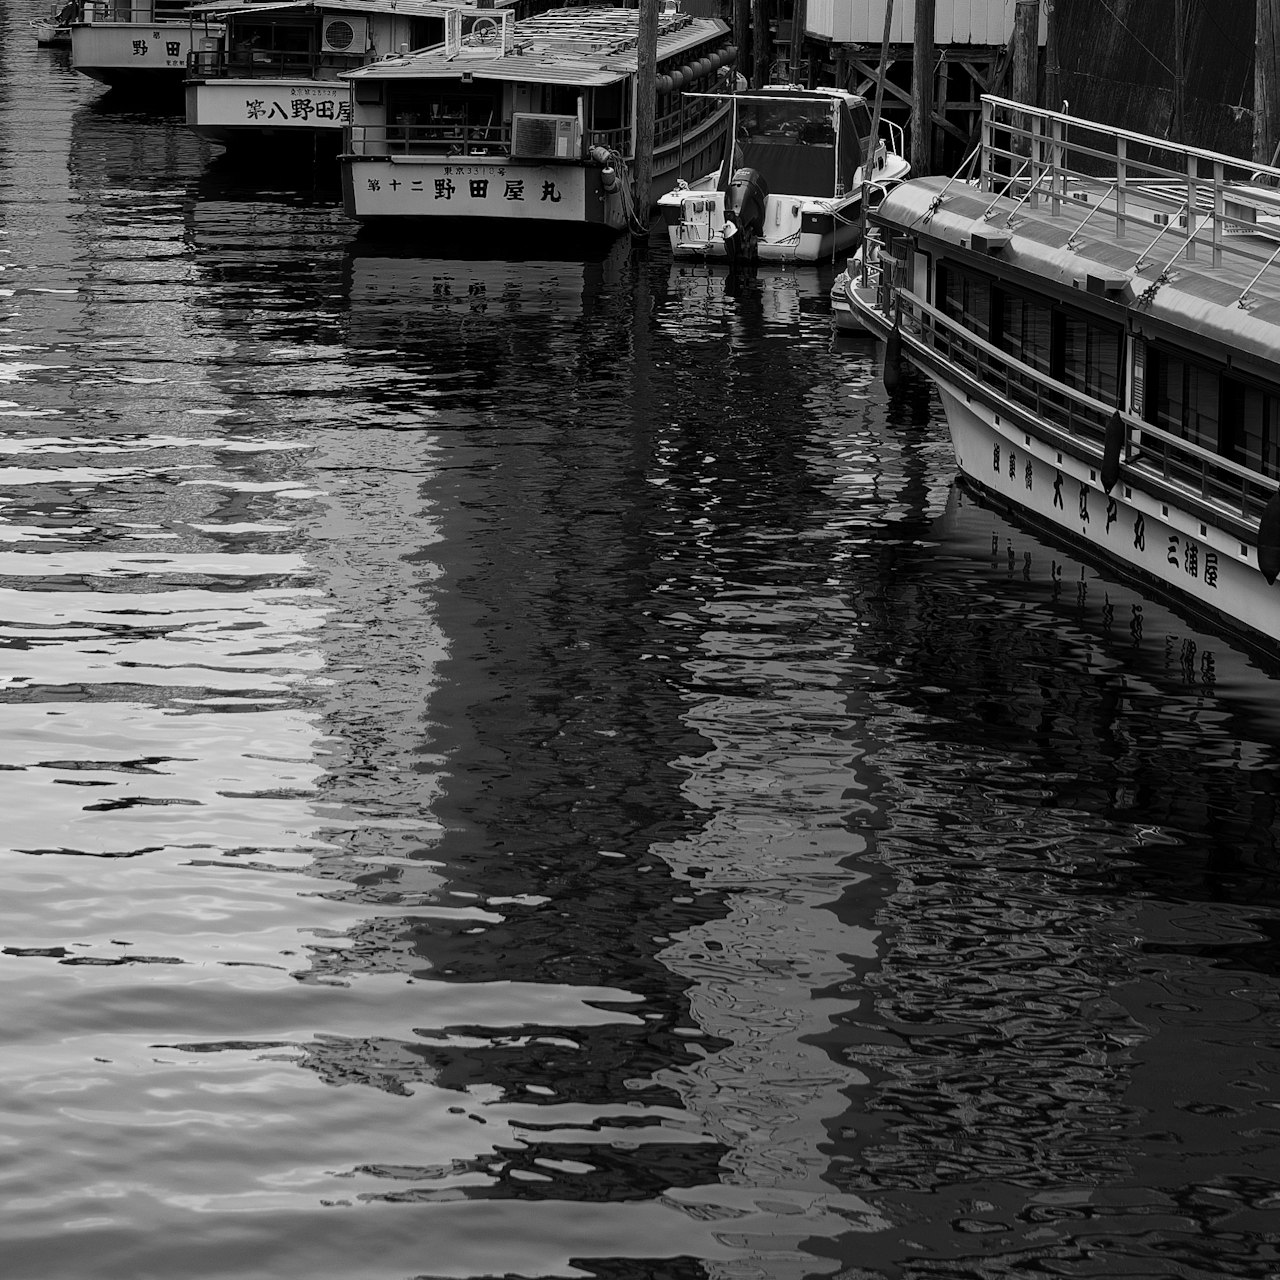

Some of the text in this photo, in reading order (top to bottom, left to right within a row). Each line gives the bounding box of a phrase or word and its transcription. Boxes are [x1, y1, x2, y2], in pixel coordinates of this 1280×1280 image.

[133, 39, 181, 57] 野田
[246, 99, 355, 122] 第八野田屋
[1167, 535, 1218, 589] 三浦屋
